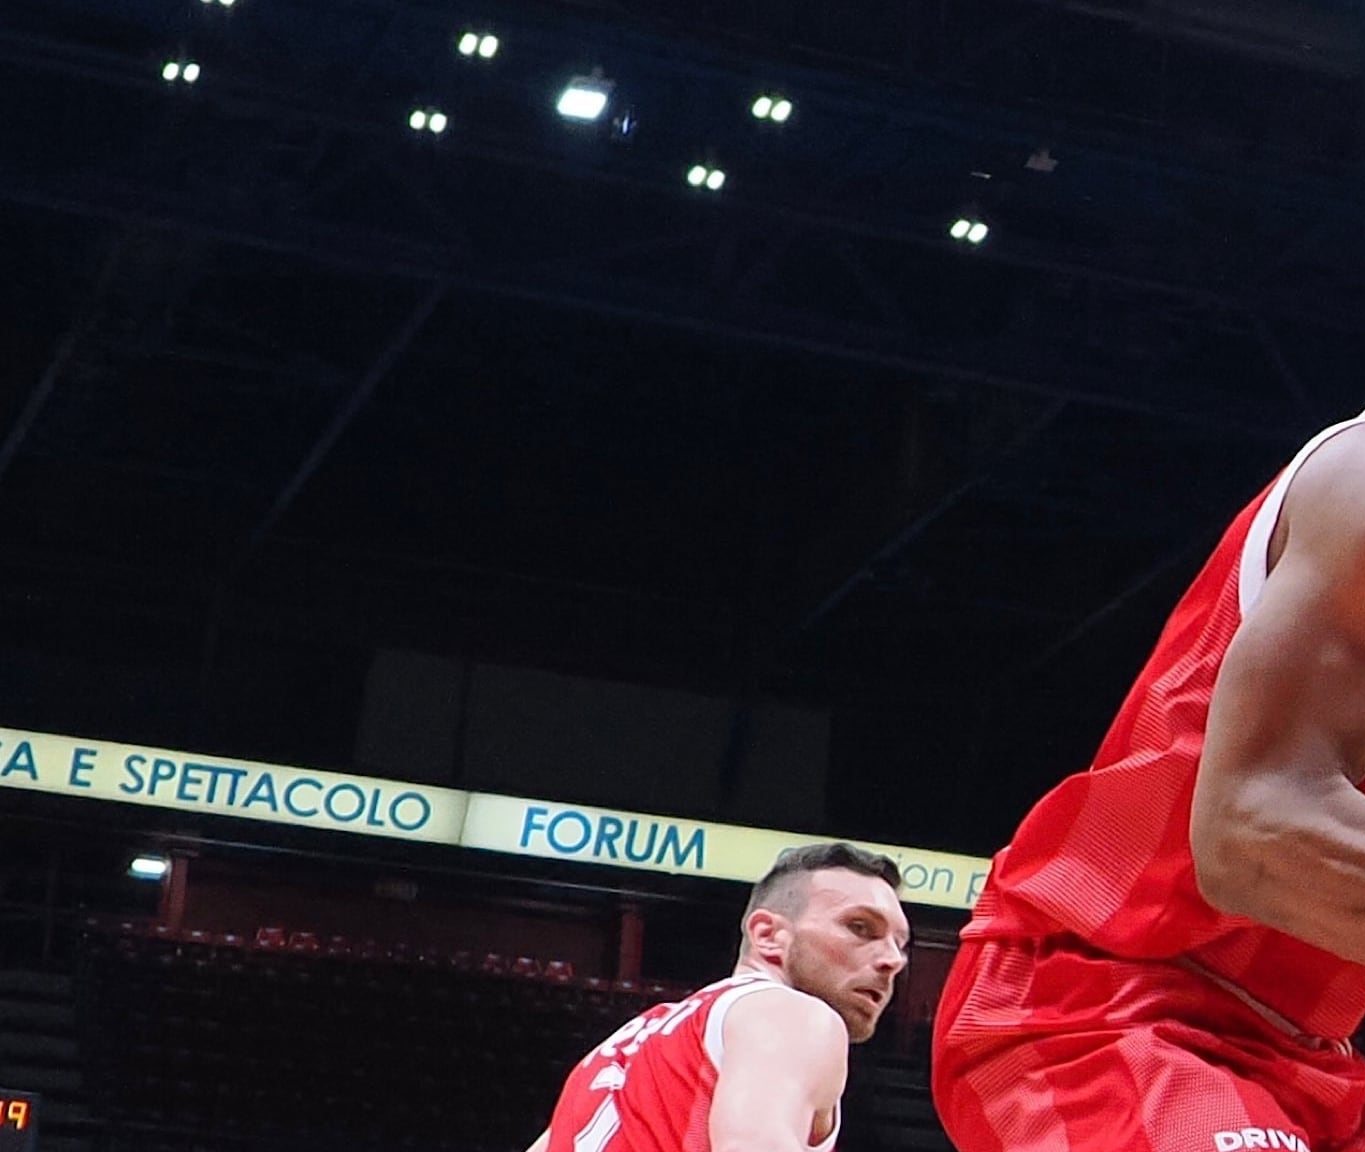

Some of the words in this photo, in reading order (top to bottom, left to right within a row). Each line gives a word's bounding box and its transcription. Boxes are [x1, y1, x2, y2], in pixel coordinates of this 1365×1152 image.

[69, 747, 97, 787] E
[120, 754, 431, 831] SPETTACOLO
[519, 807, 705, 869] FORUM
